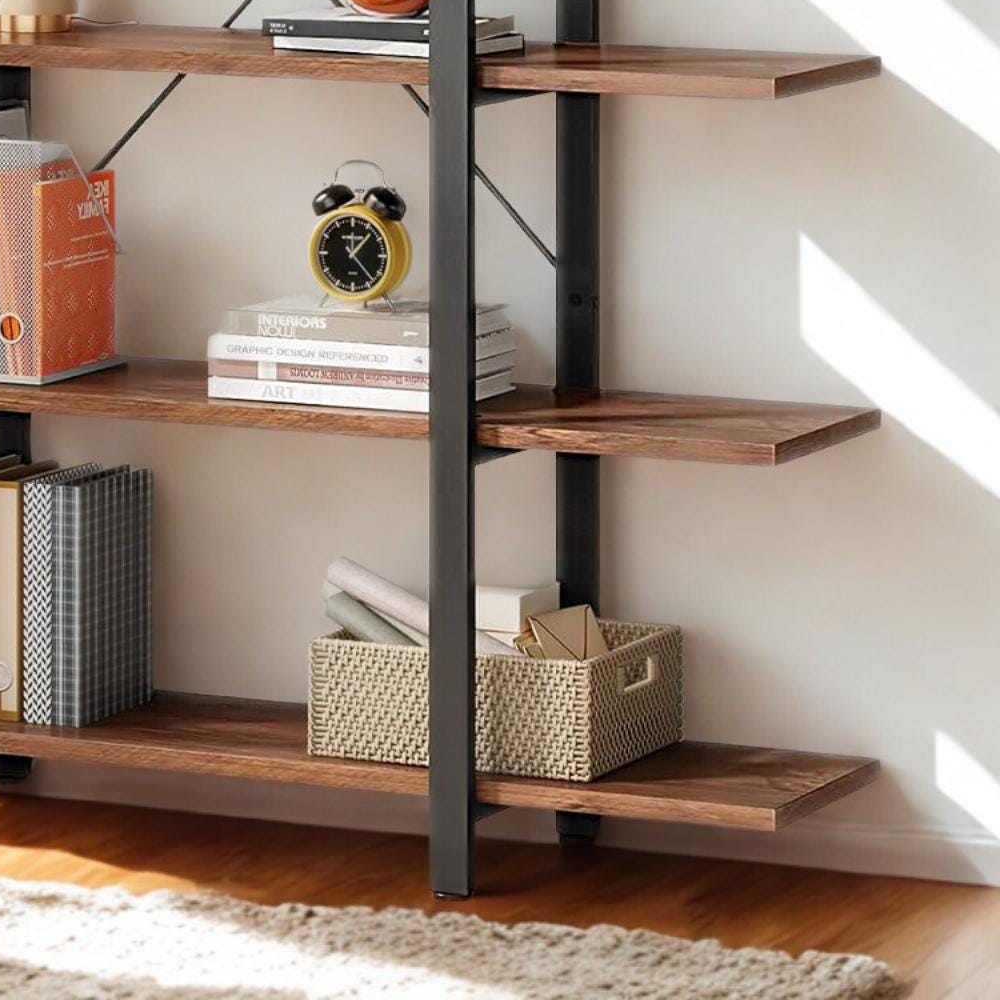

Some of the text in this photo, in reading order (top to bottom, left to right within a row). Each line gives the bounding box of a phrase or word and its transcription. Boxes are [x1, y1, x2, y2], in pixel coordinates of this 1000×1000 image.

[257, 313, 326, 328] INTERIORS
[226, 343, 389, 363] GRAPHIC DESIGN REFERENCED
[262, 383, 297, 399] ART
